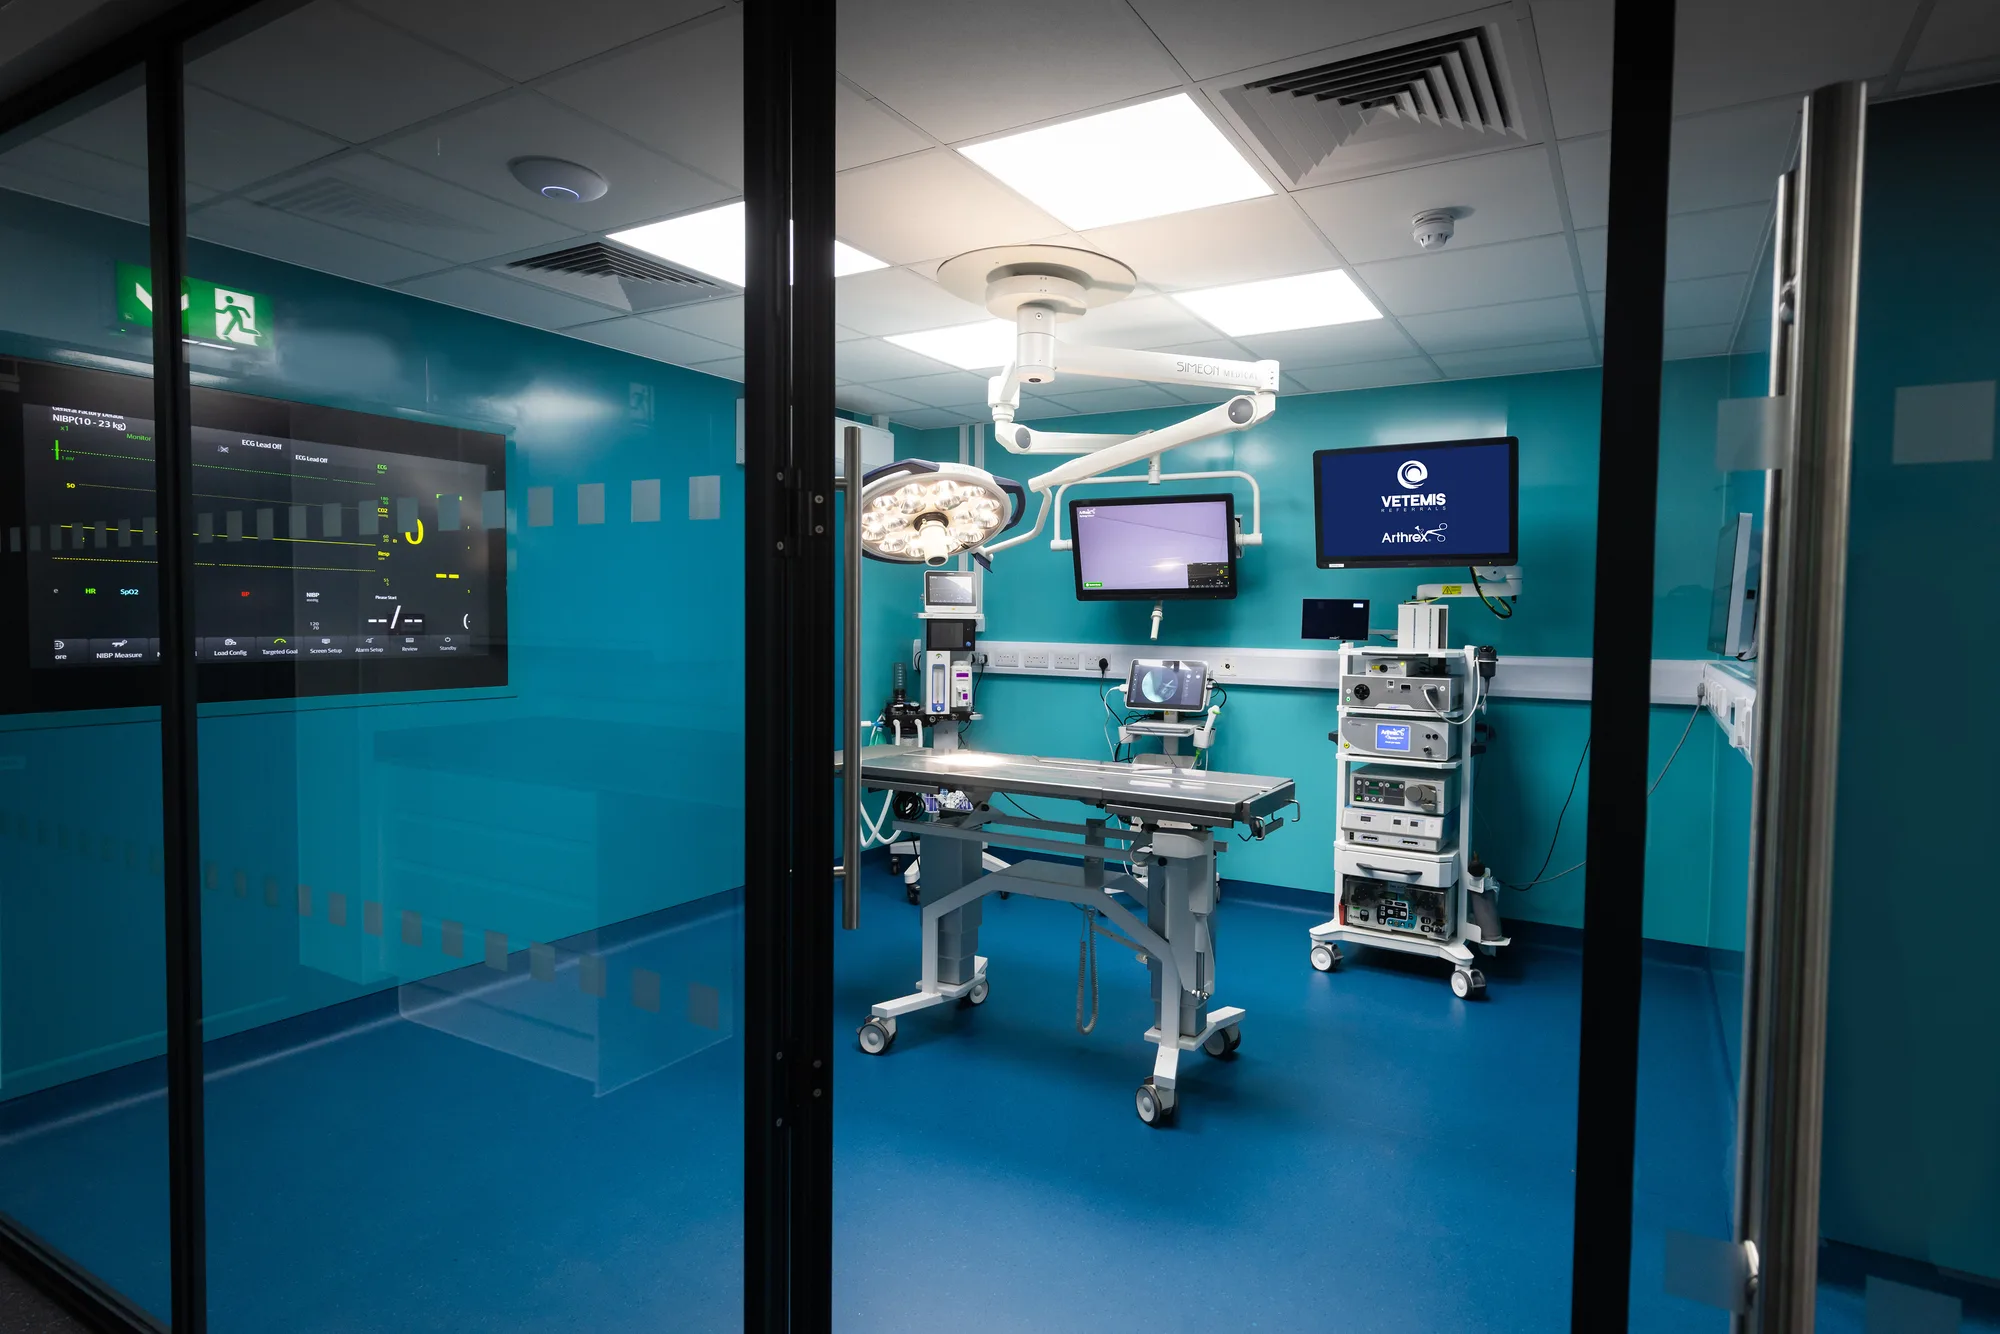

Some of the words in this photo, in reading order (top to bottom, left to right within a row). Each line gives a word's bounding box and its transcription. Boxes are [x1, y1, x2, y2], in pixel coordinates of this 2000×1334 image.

[1176, 362, 1220, 376] SIMEON
[1224, 370, 1258, 380] MEDICAL
[112, 421, 126, 431] kg)
[256, 441, 271, 449] Lead
[1381, 493, 1446, 507] VETEMIS
[1382, 530, 1428, 543] Arthrex
